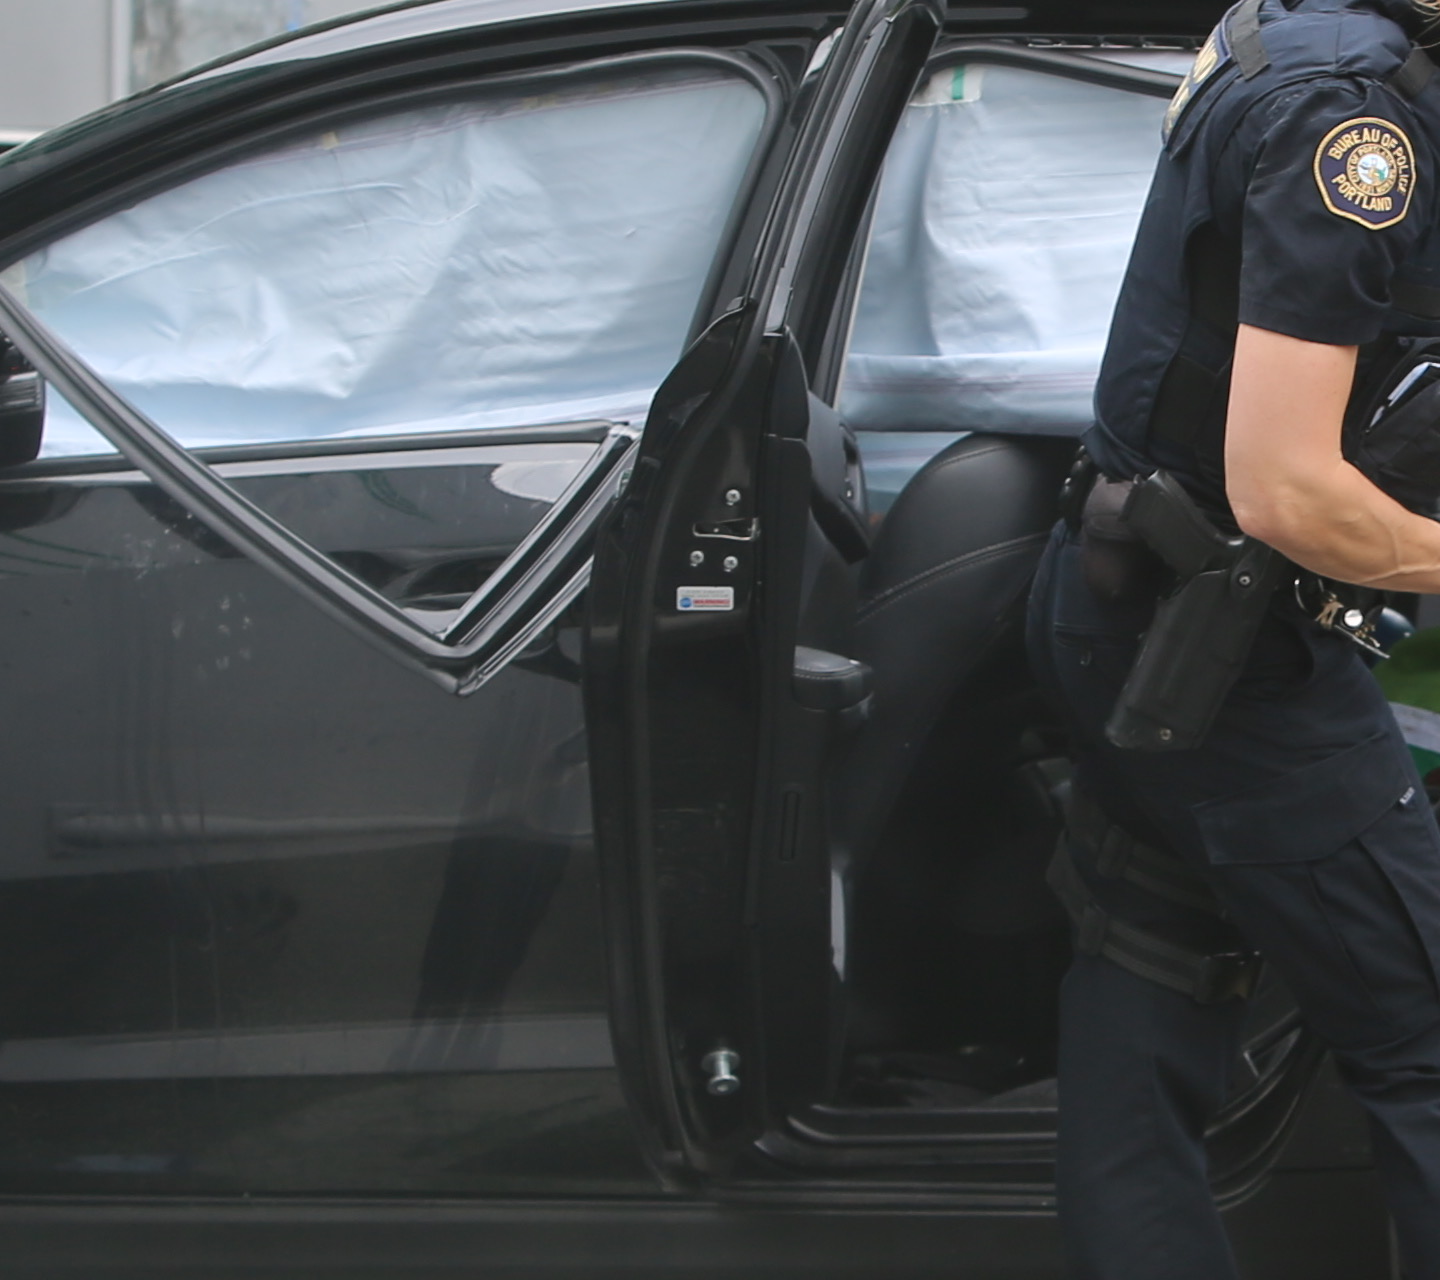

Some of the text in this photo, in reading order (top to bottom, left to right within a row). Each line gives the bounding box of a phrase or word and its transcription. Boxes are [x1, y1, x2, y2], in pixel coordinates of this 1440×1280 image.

[1328, 127, 1380, 161] BUREAU
[1381, 133, 1399, 150] OF
[1331, 173, 1393, 212] PORTLAND
